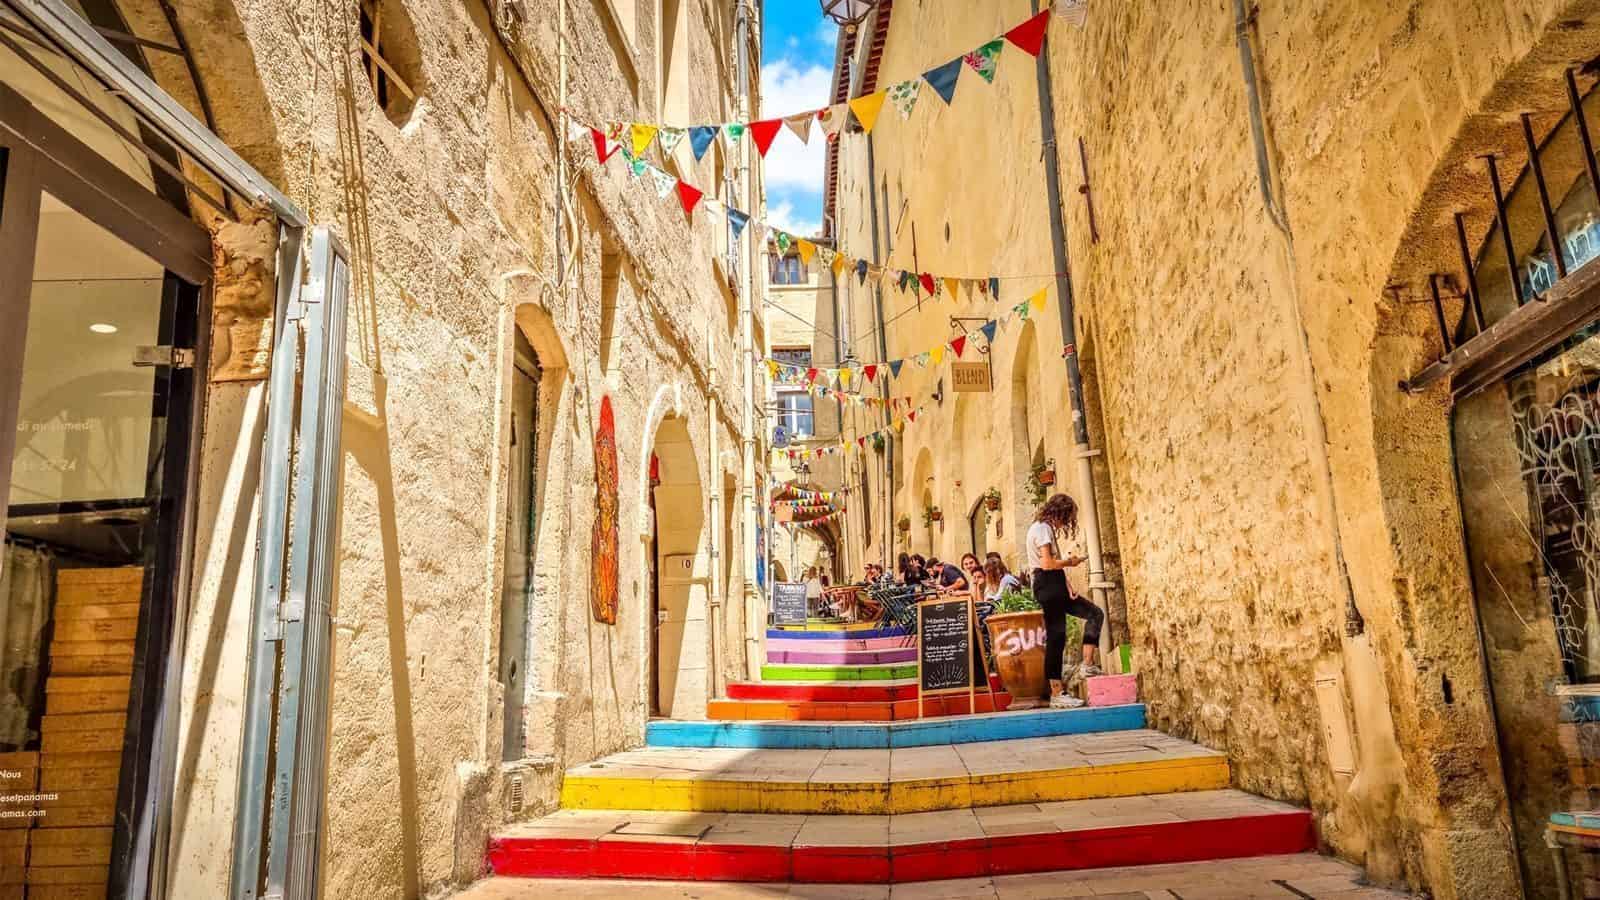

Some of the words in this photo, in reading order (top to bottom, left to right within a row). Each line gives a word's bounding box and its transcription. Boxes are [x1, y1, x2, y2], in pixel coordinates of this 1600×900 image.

[956, 368, 985, 385] BLEND
[681, 559, 692, 569] 10
[0, 809, 47, 818] amas.com
